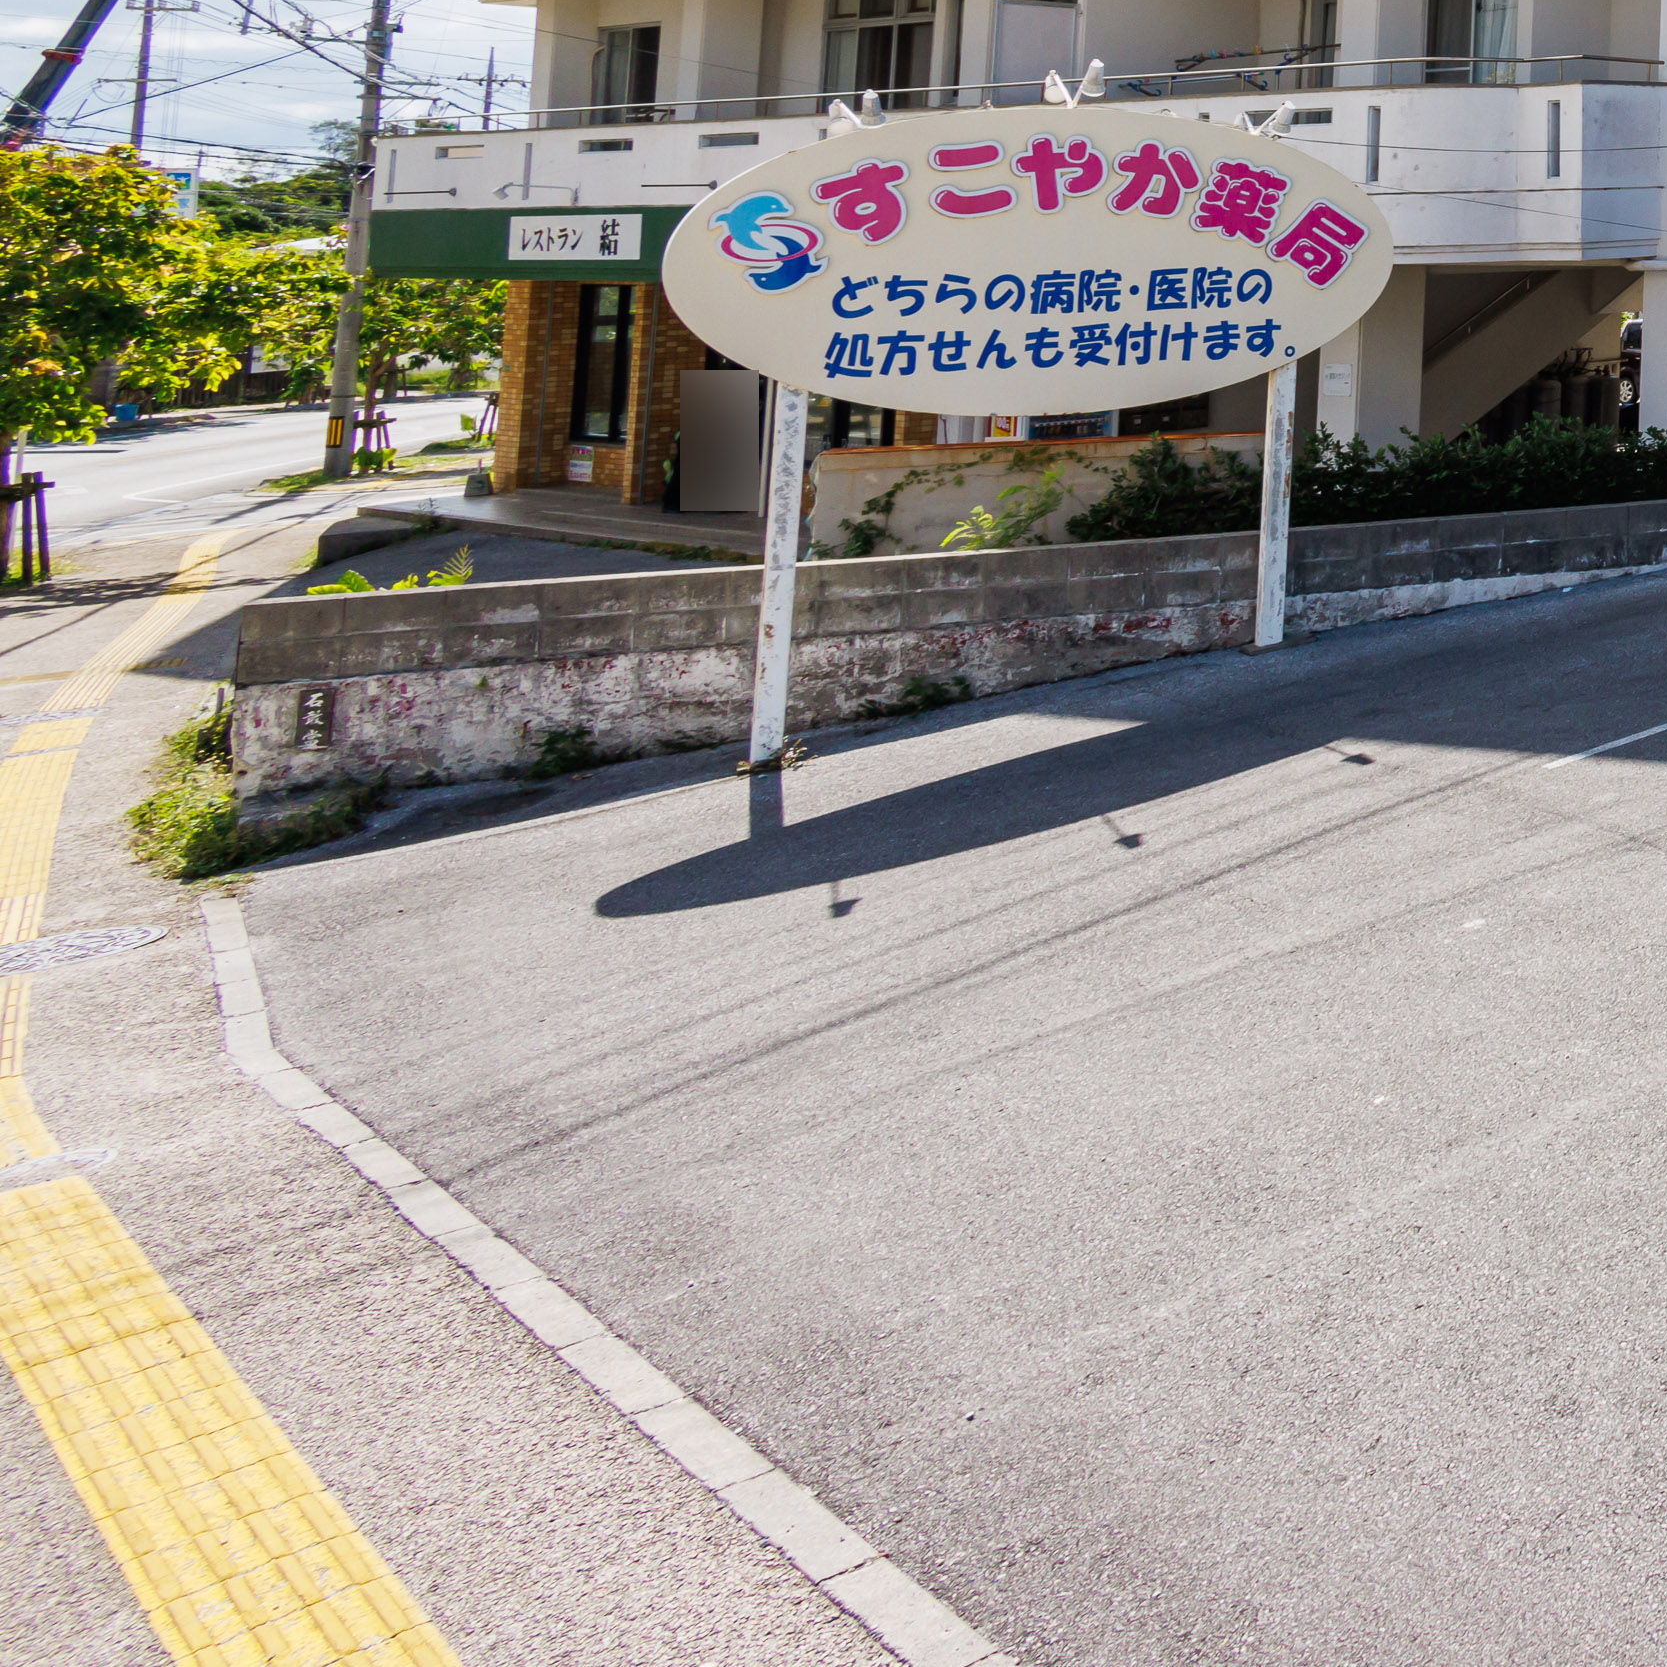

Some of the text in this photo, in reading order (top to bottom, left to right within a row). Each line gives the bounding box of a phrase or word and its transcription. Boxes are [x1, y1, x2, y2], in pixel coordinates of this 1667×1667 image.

[521, 218, 620, 256] レストラン 結
[809, 133, 1370, 290] すこやか薬局
[832, 267, 1273, 319] どちらの病院・医院の
[824, 318, 1297, 379] 処方せんも受付けます。
